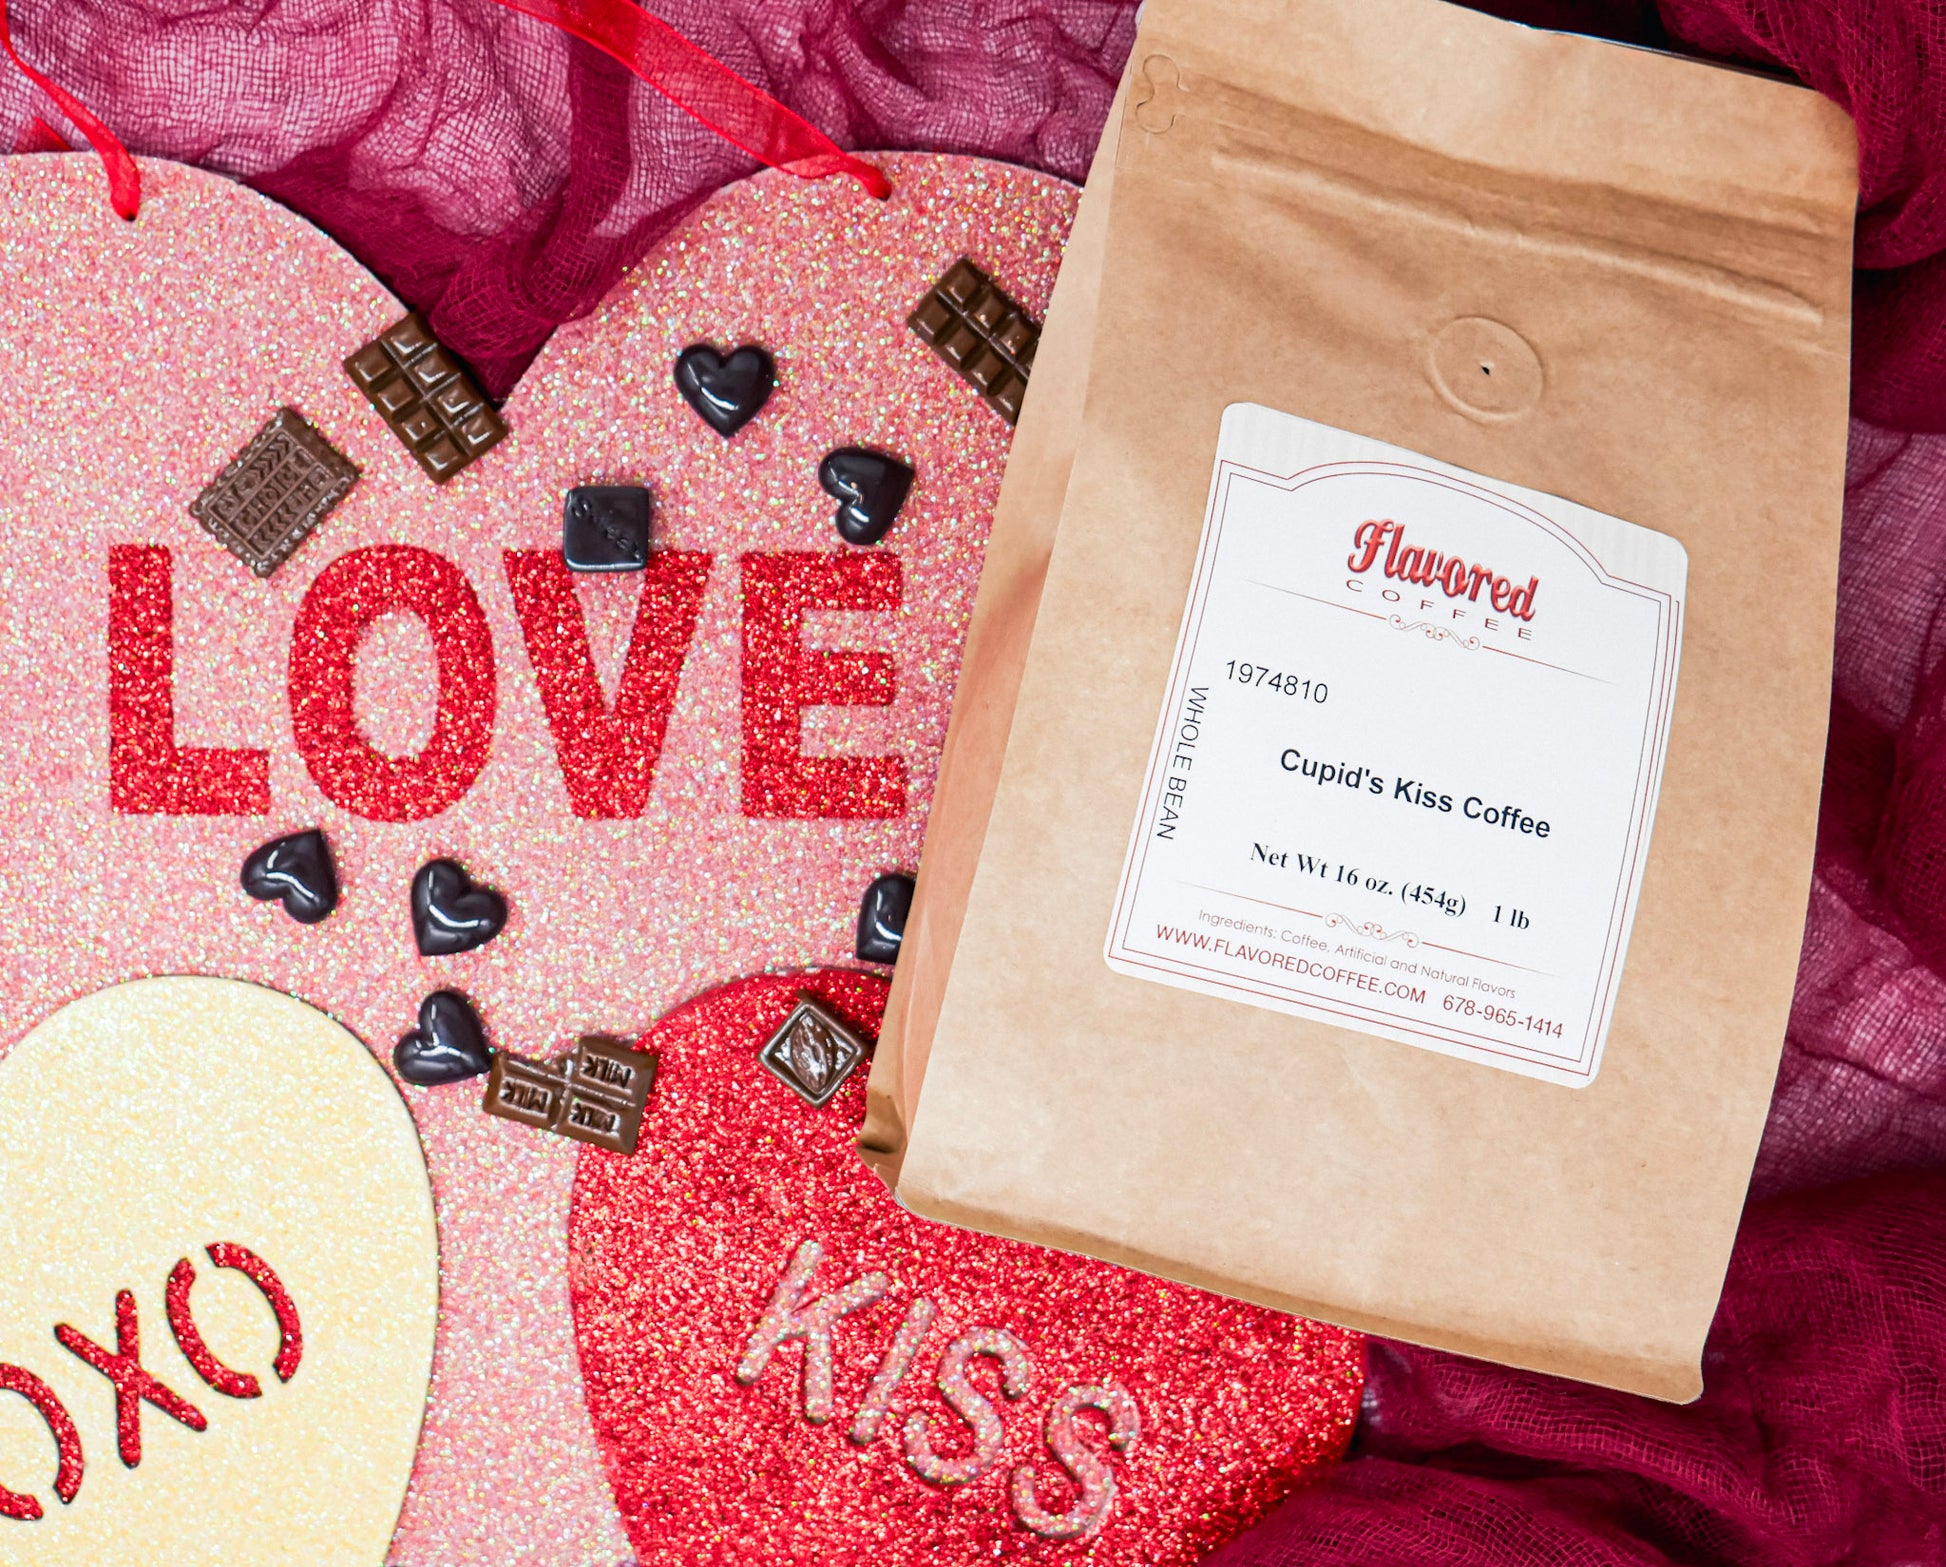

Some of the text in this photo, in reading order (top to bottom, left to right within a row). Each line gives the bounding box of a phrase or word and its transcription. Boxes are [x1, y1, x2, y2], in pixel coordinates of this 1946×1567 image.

[1346, 579, 1532, 640] COFFEE
[1347, 518, 1539, 621] Flavored
[107, 544, 905, 822] LOVE
[1226, 660, 1328, 704] 1974810
[1156, 688, 1209, 840] WHOLE BEAN
[1280, 749, 1550, 838] Cupid's Kiss Coffee
[1250, 842, 1530, 929] Net Wt 16 oz. (454g) 1 lb
[1157, 924, 1563, 1039] WWW.FLAVOREDCOFFEE.COM 678-965-1414
[1198, 909, 1277, 938] Ingredients:
[1335, 945, 1387, 965] Artificial
[1389, 959, 1418, 974] and
[1421, 966, 1469, 987] Natural
[1472, 977, 1517, 998] Flavors
[500, 1078, 550, 1114] MILK
[580, 1055, 632, 1089] MILK
[736, 1239, 1141, 1539] KISS
